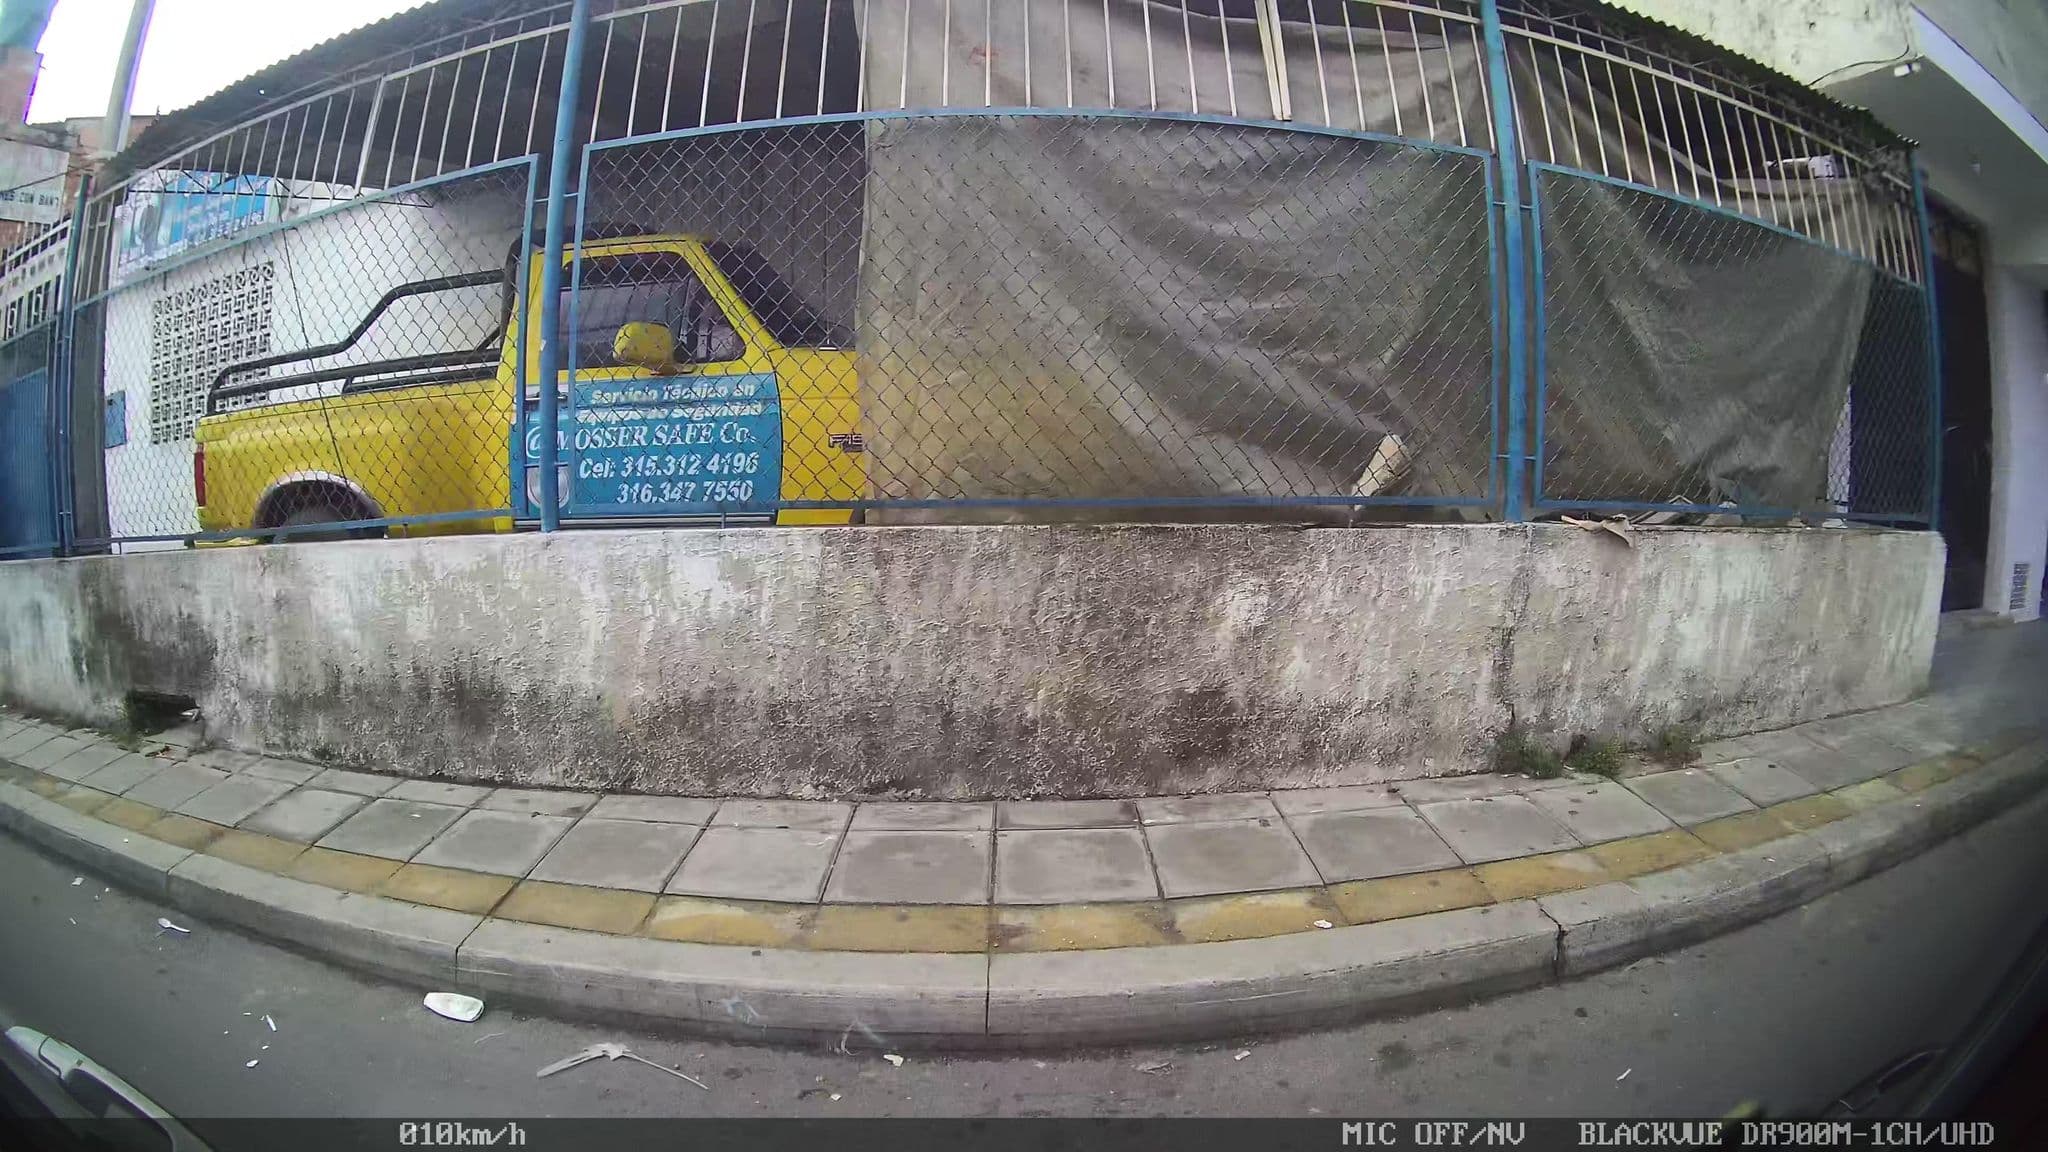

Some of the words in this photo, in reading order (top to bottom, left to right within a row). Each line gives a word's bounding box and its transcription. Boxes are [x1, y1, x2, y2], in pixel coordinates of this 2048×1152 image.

[591, 386, 658, 404] Servicio
[662, 384, 728, 400] Técnico
[733, 384, 755, 397] en
[652, 422, 716, 447] SAFE
[620, 453, 701, 478] 315.312
